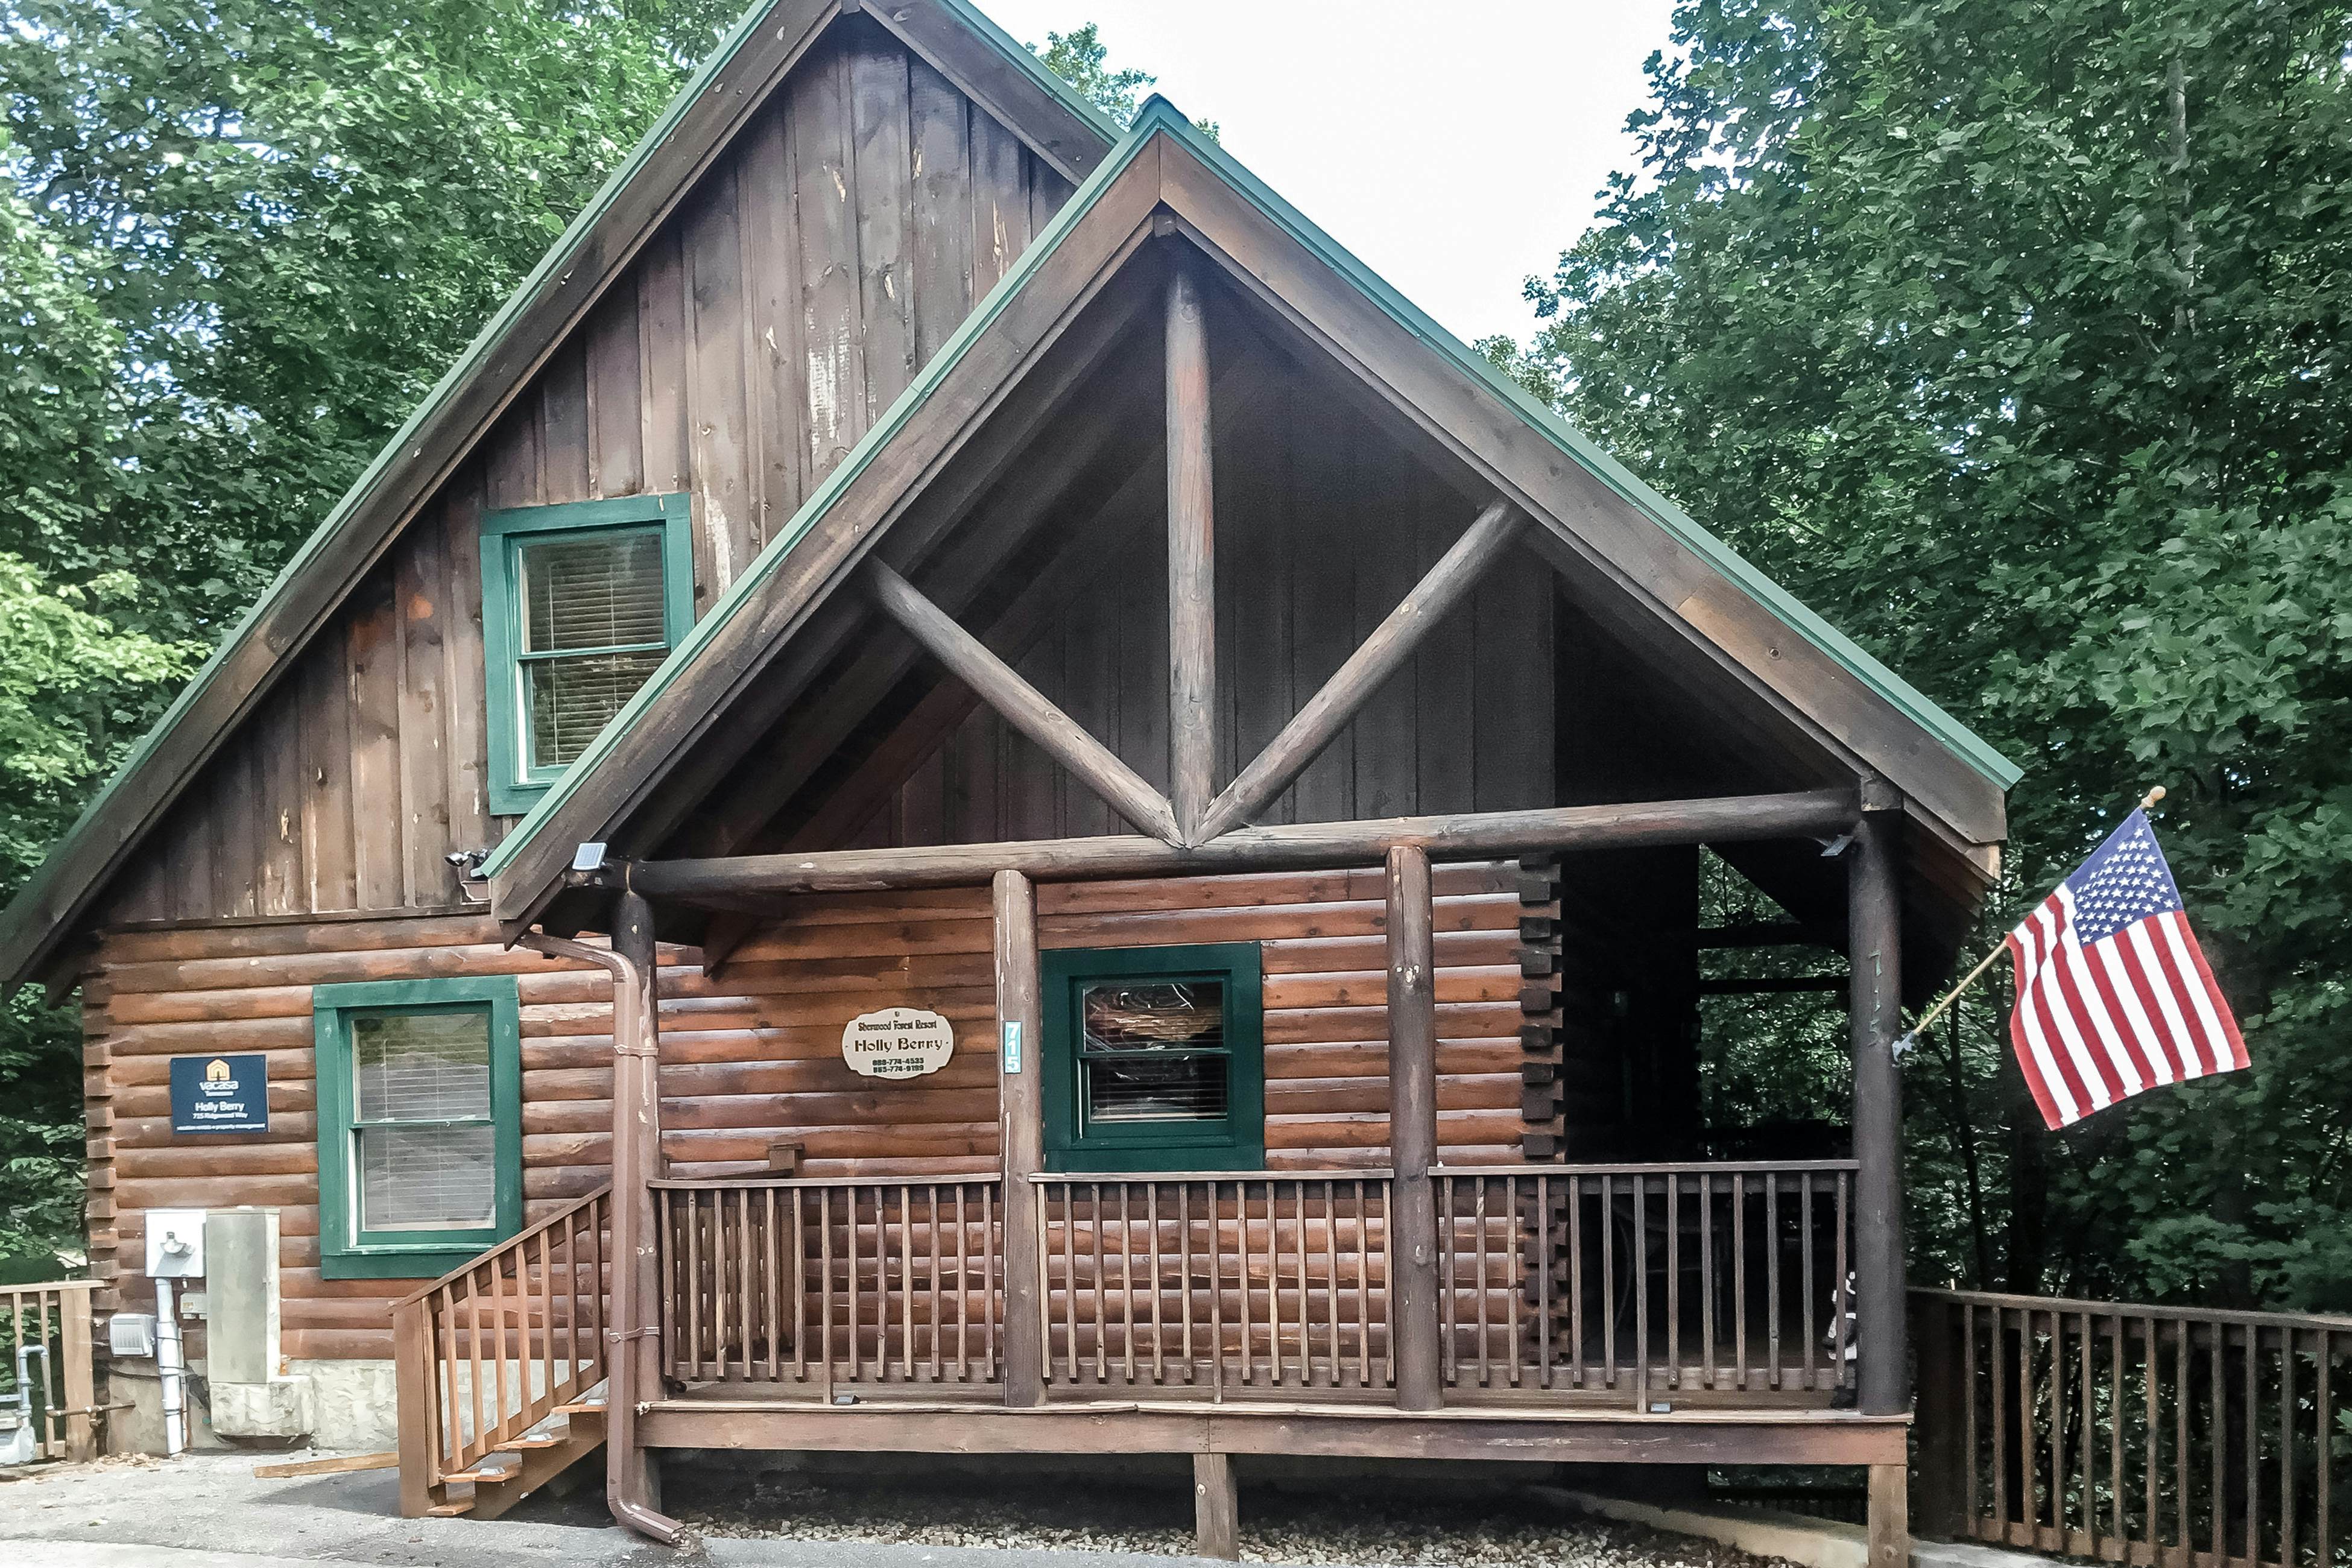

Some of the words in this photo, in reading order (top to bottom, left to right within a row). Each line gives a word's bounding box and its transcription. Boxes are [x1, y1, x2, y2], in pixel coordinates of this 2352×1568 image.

[858, 1021, 891, 1031] Sherwood
[893, 1020, 913, 1029] Forest
[915, 1020, 937, 1029] Resort
[855, 1039, 892, 1052] Holly
[898, 1038, 942, 1050] Berry
[1007, 1024, 1019, 1071] 715
[195, 1102, 218, 1112] Holly
[220, 1101, 245, 1111] Berry
